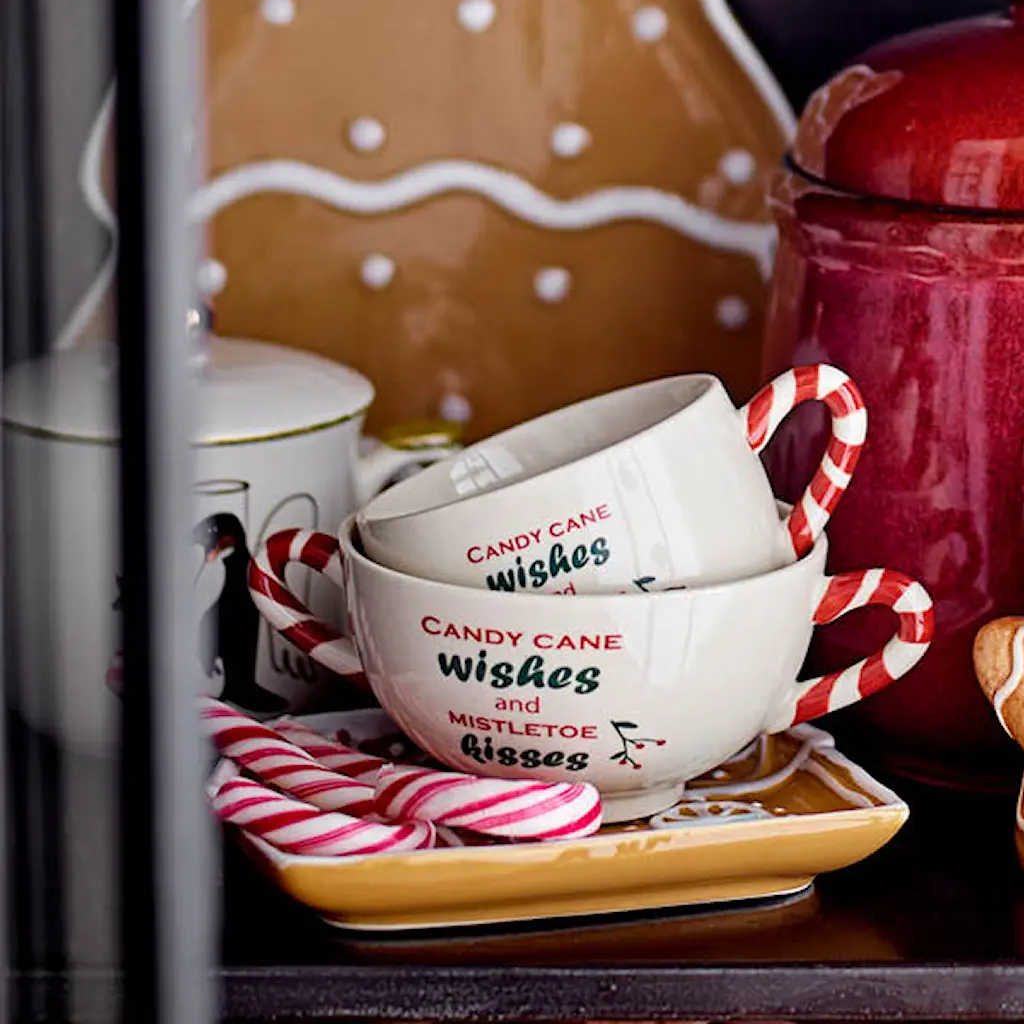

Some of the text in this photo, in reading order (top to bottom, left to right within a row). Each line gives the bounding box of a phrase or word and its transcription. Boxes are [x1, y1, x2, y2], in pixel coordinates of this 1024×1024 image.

[465, 504, 612, 564] CANDY CANE
[485, 537, 611, 593] wishes
[420, 615, 624, 650] CANDY CANE
[437, 650, 601, 695] wishes
[447, 709, 599, 739] MISTLETOE
[495, 696, 541, 714] and
[460, 733, 590, 772] kisses
